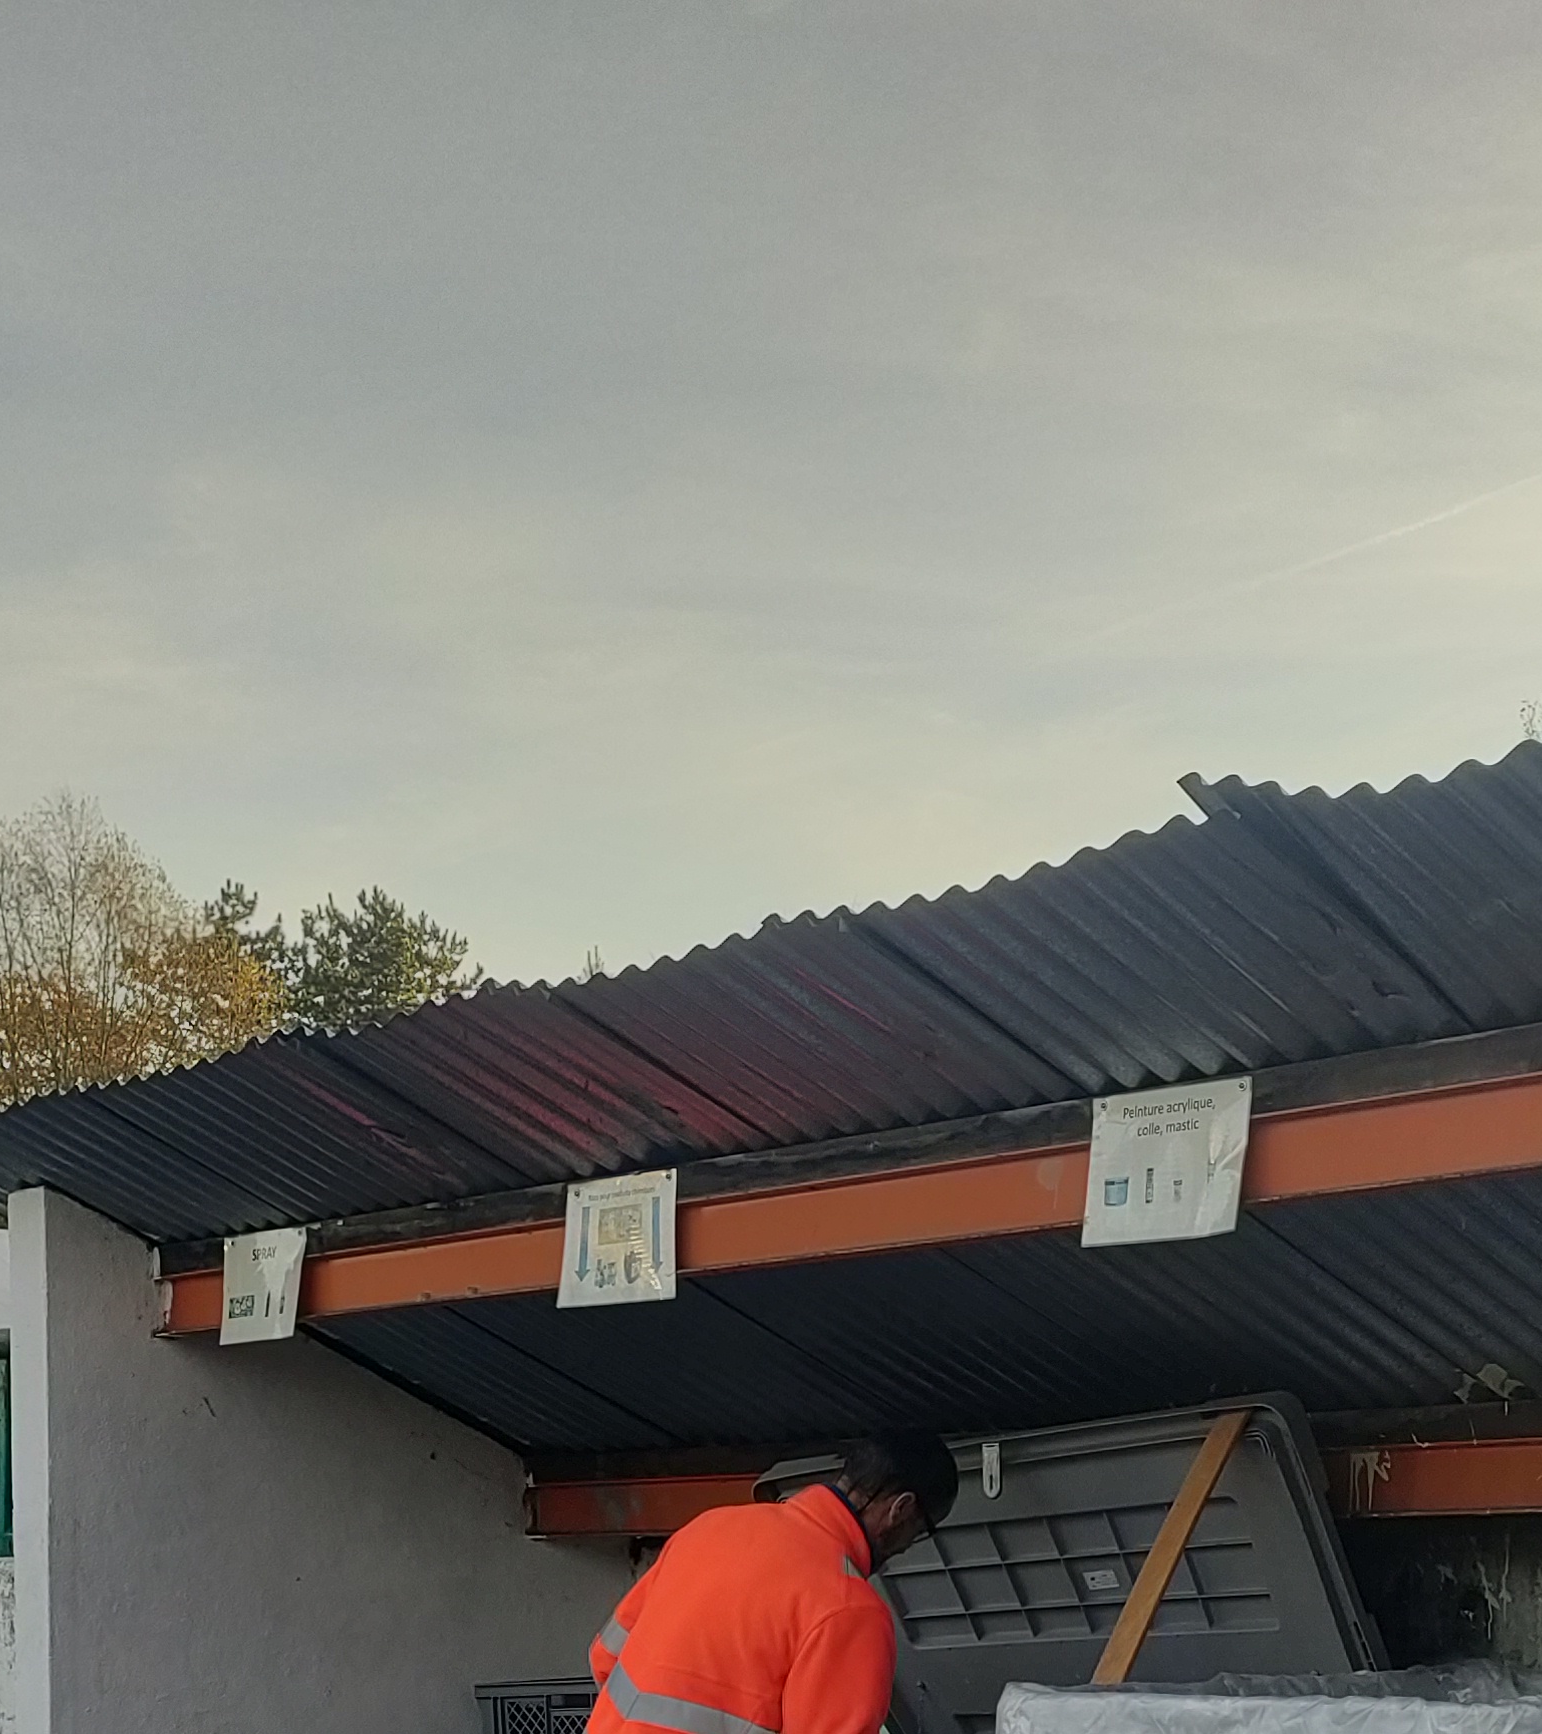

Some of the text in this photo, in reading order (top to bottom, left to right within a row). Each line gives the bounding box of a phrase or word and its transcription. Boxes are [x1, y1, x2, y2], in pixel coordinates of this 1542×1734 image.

[1123, 1098, 1215, 1119] Peinture acrylique,
[1138, 1118, 1199, 1136] colle, mastic
[252, 1246, 277, 1261] SPRAY
